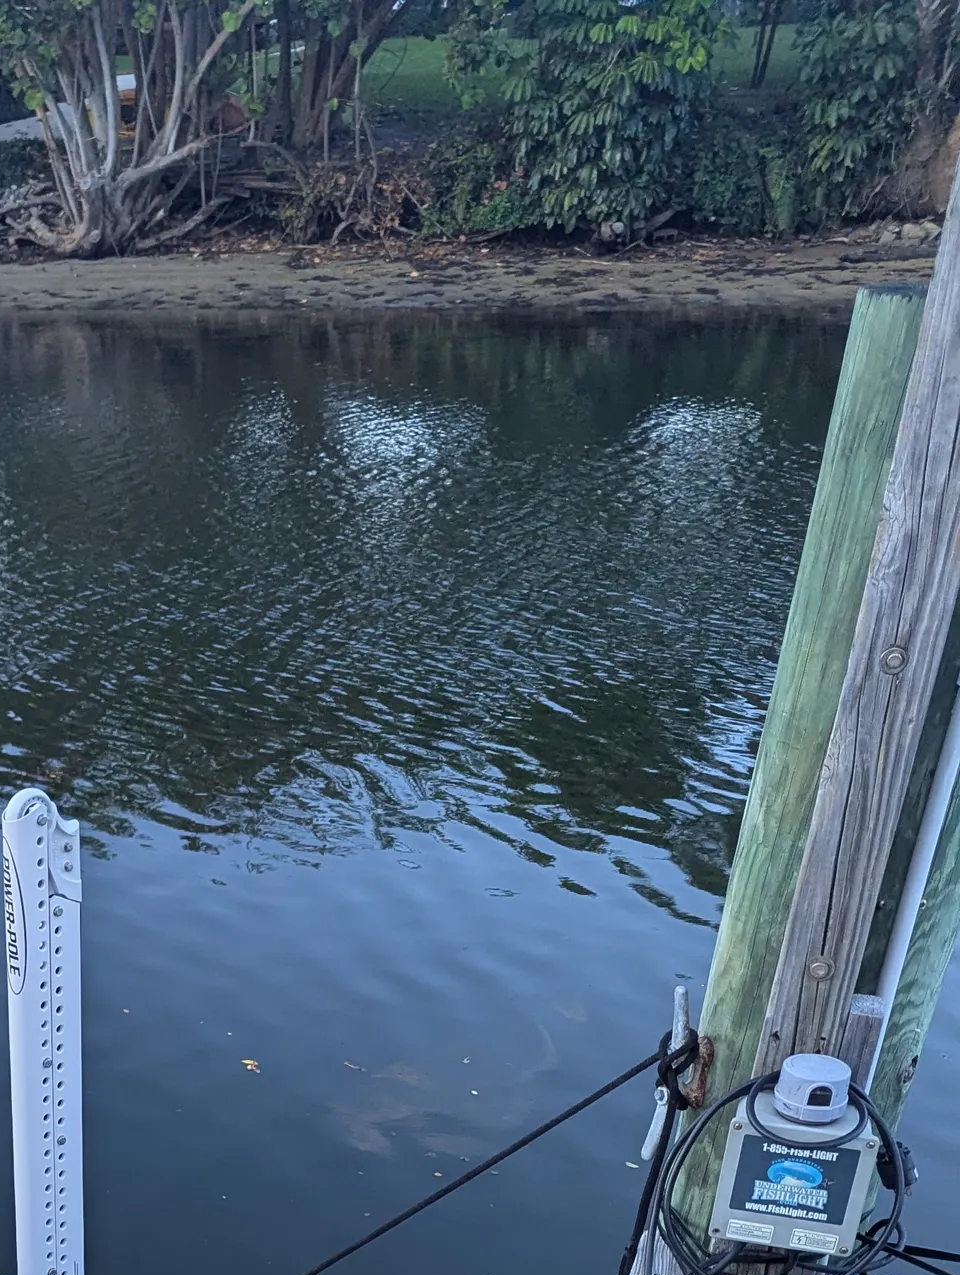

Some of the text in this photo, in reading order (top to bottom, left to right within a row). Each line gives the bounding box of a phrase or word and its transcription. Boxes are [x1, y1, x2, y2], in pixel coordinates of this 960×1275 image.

[2, 855, 21, 978] POWER-POLE
[751, 1188, 828, 1210] FISHLIGHT
[754, 1180, 828, 1197] UNDERWATER
[745, 1201, 828, 1221] www.FishLight.com
